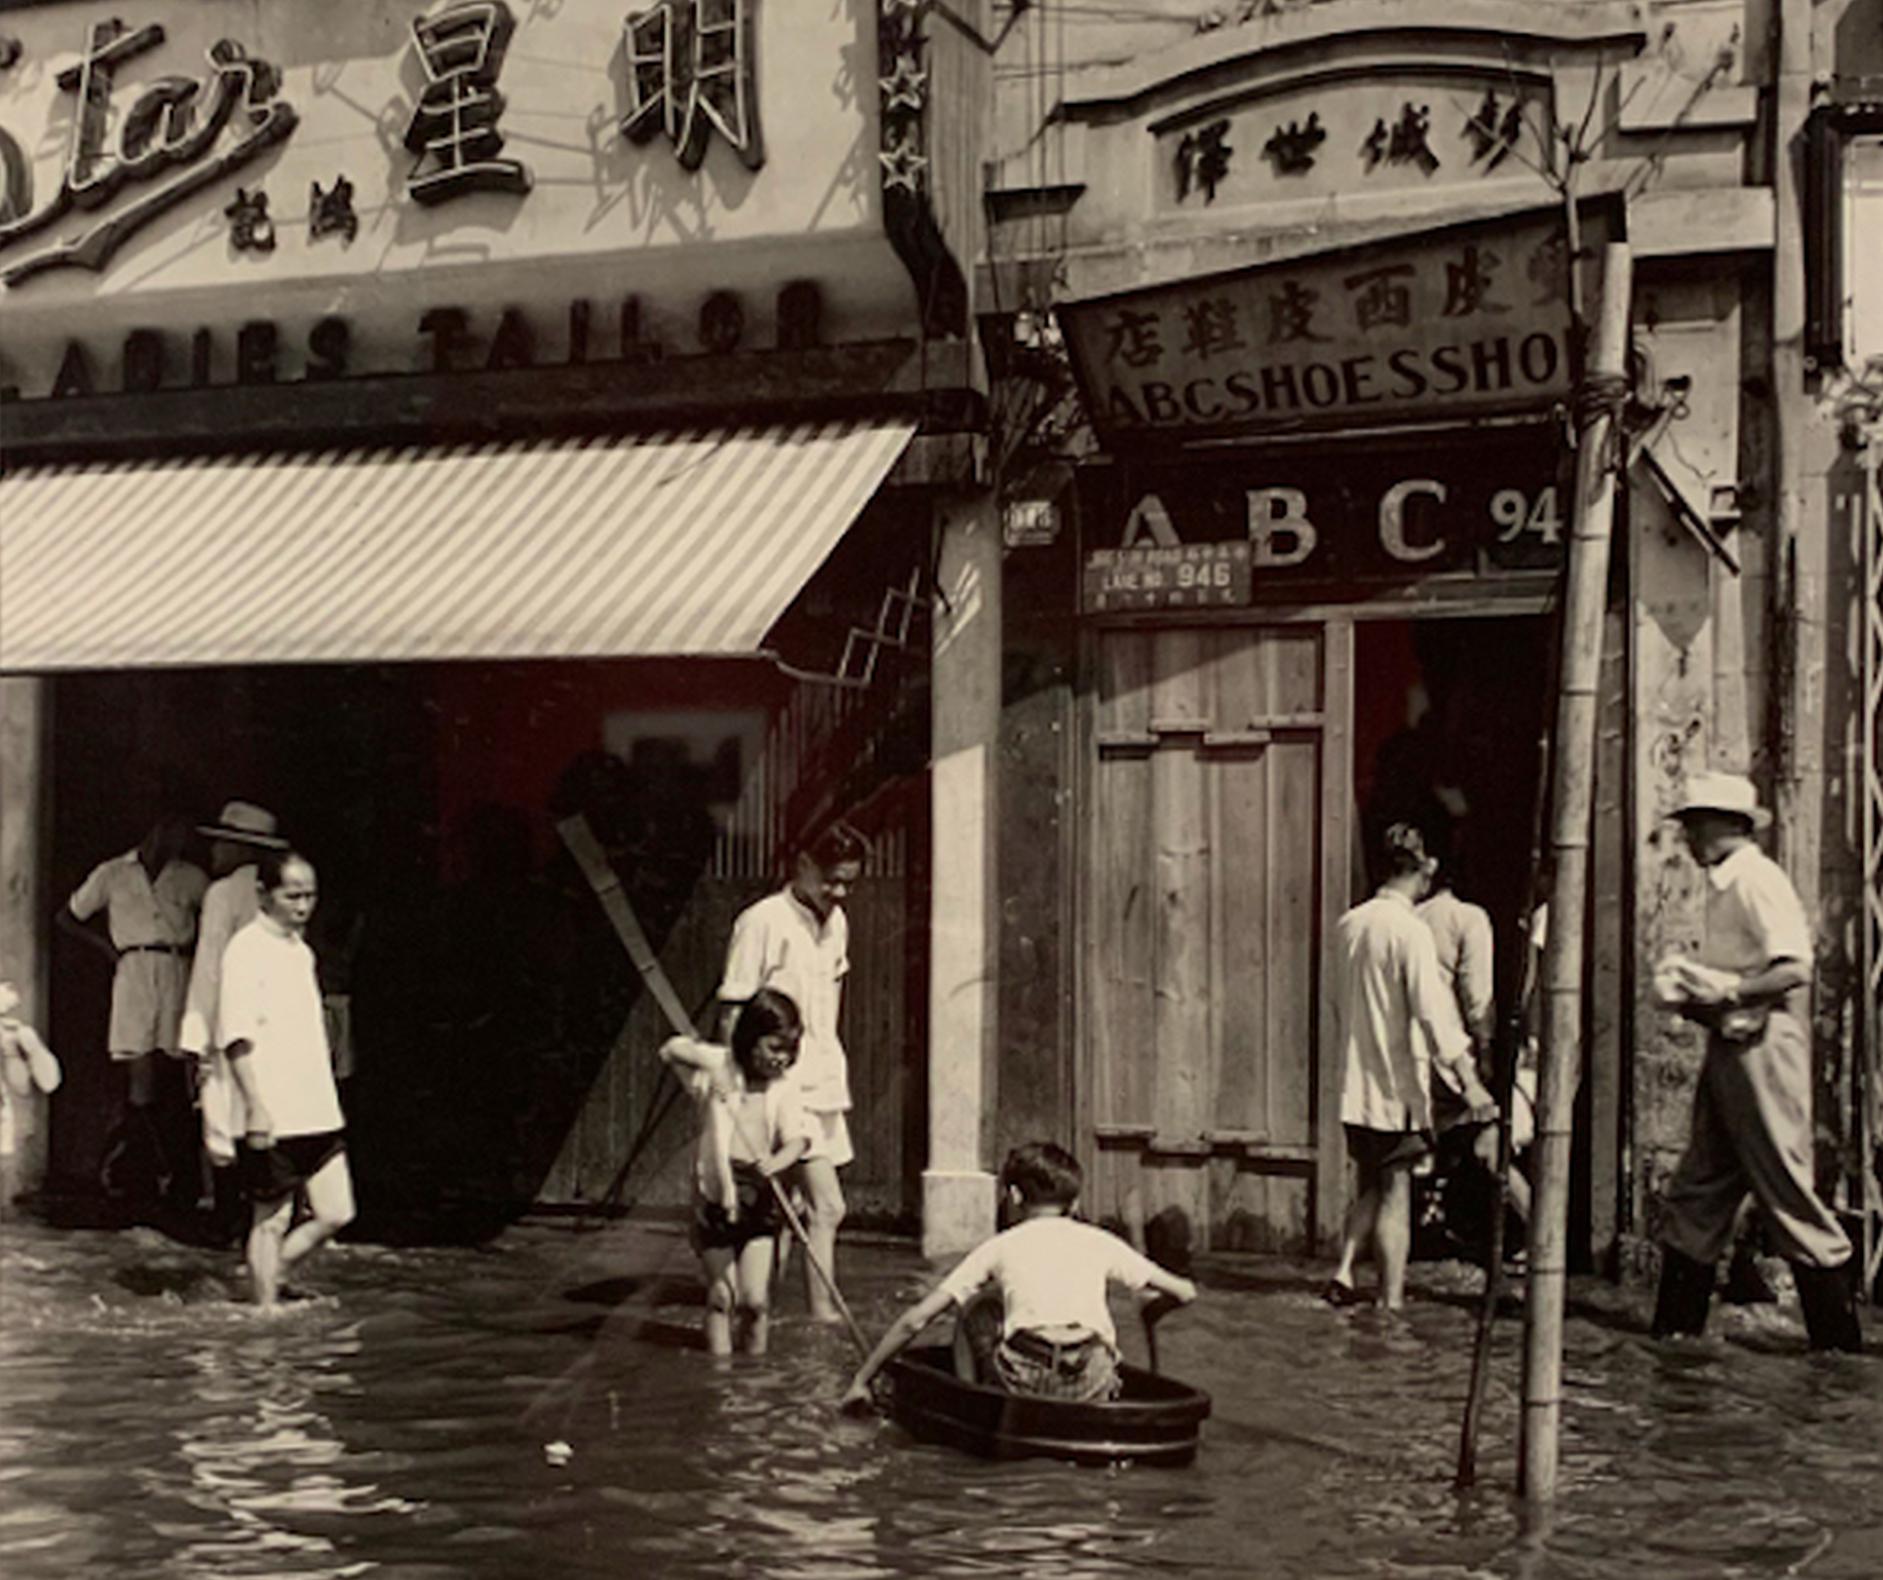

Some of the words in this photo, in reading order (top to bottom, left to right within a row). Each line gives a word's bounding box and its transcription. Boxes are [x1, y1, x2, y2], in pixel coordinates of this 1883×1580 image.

[0, 316, 350, 398] ADIES
[417, 280, 823, 375] TAILOR
[1176, 563, 1231, 587] 946
